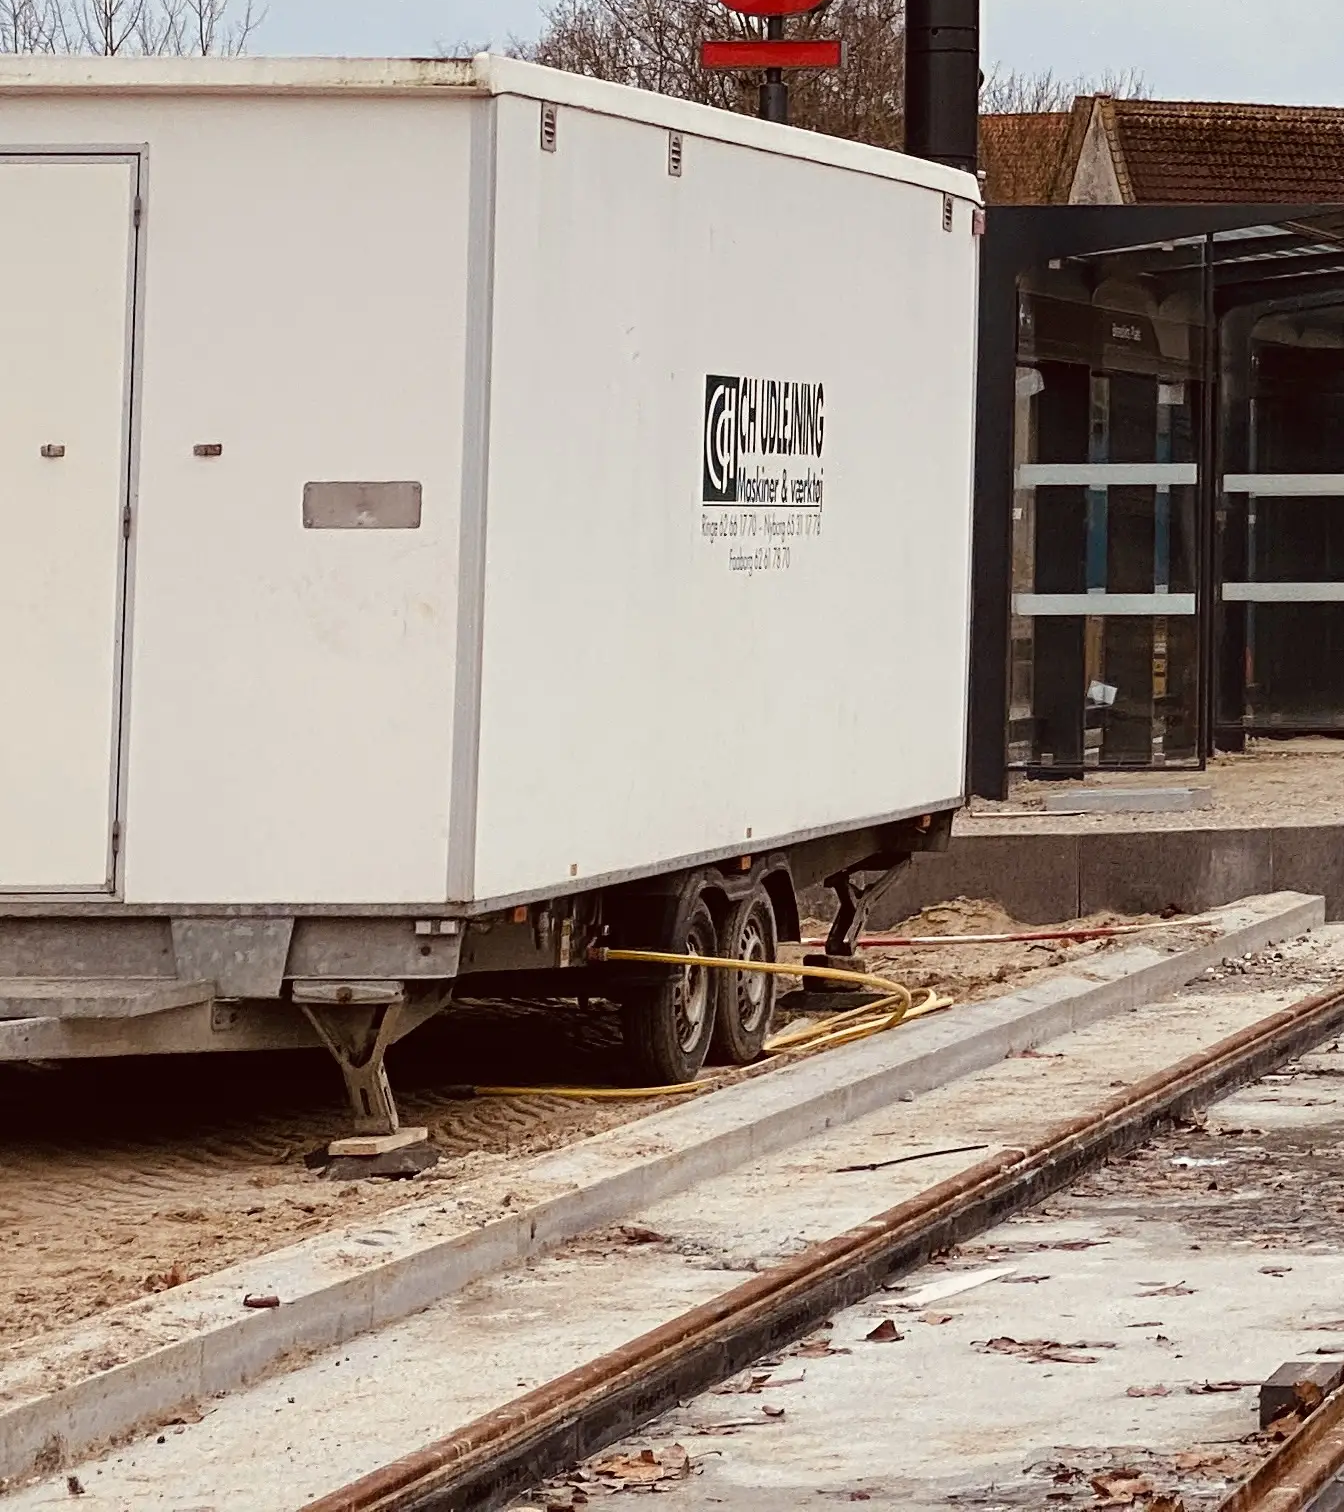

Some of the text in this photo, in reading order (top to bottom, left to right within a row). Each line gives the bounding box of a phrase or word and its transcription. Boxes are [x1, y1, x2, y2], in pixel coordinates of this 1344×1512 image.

[739, 377, 825, 458] CH UDLEJNING
[737, 466, 779, 503] Maskiner
[781, 468, 788, 503] &
